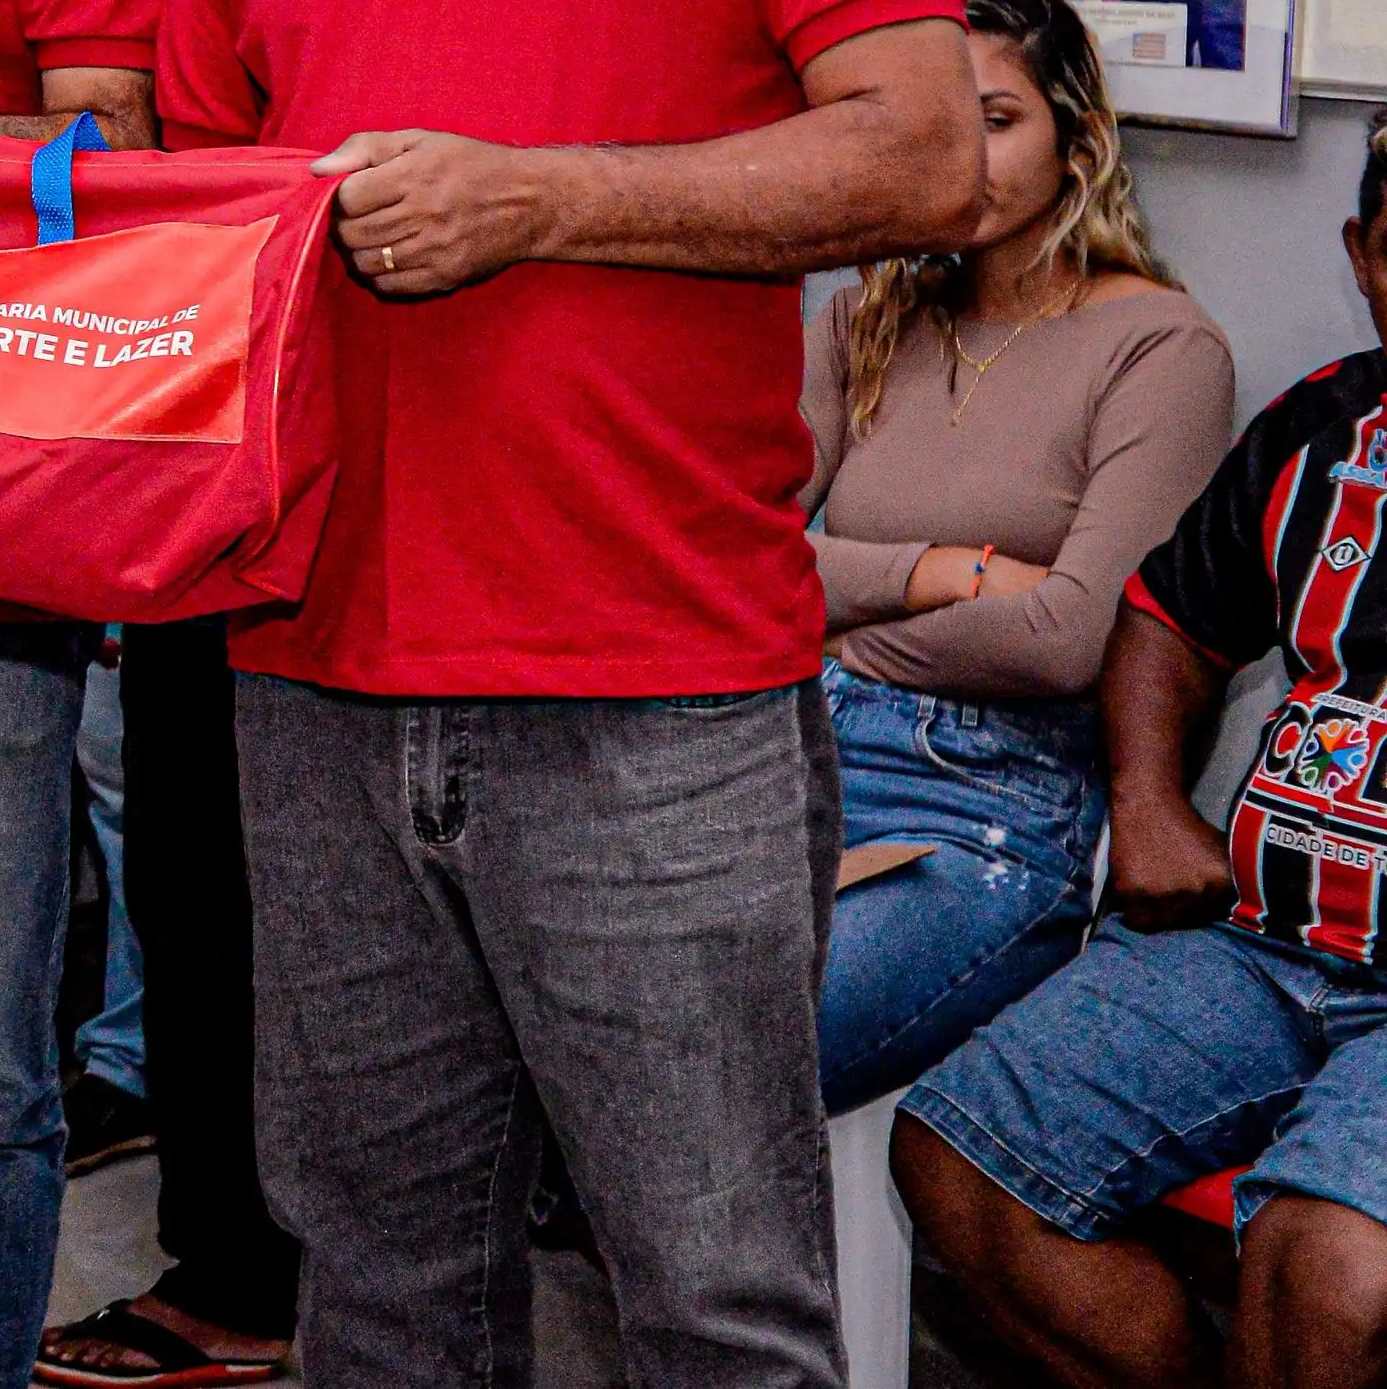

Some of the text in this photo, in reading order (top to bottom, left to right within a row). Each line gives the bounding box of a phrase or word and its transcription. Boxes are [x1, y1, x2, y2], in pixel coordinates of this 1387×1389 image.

[52, 306, 168, 335] MUNICIPAL
[171, 304, 201, 324] DE
[63, 340, 89, 366] E
[93, 329, 196, 369] LAZER
[1266, 825, 1336, 858] CIDADE
[1340, 844, 1369, 867] DE
